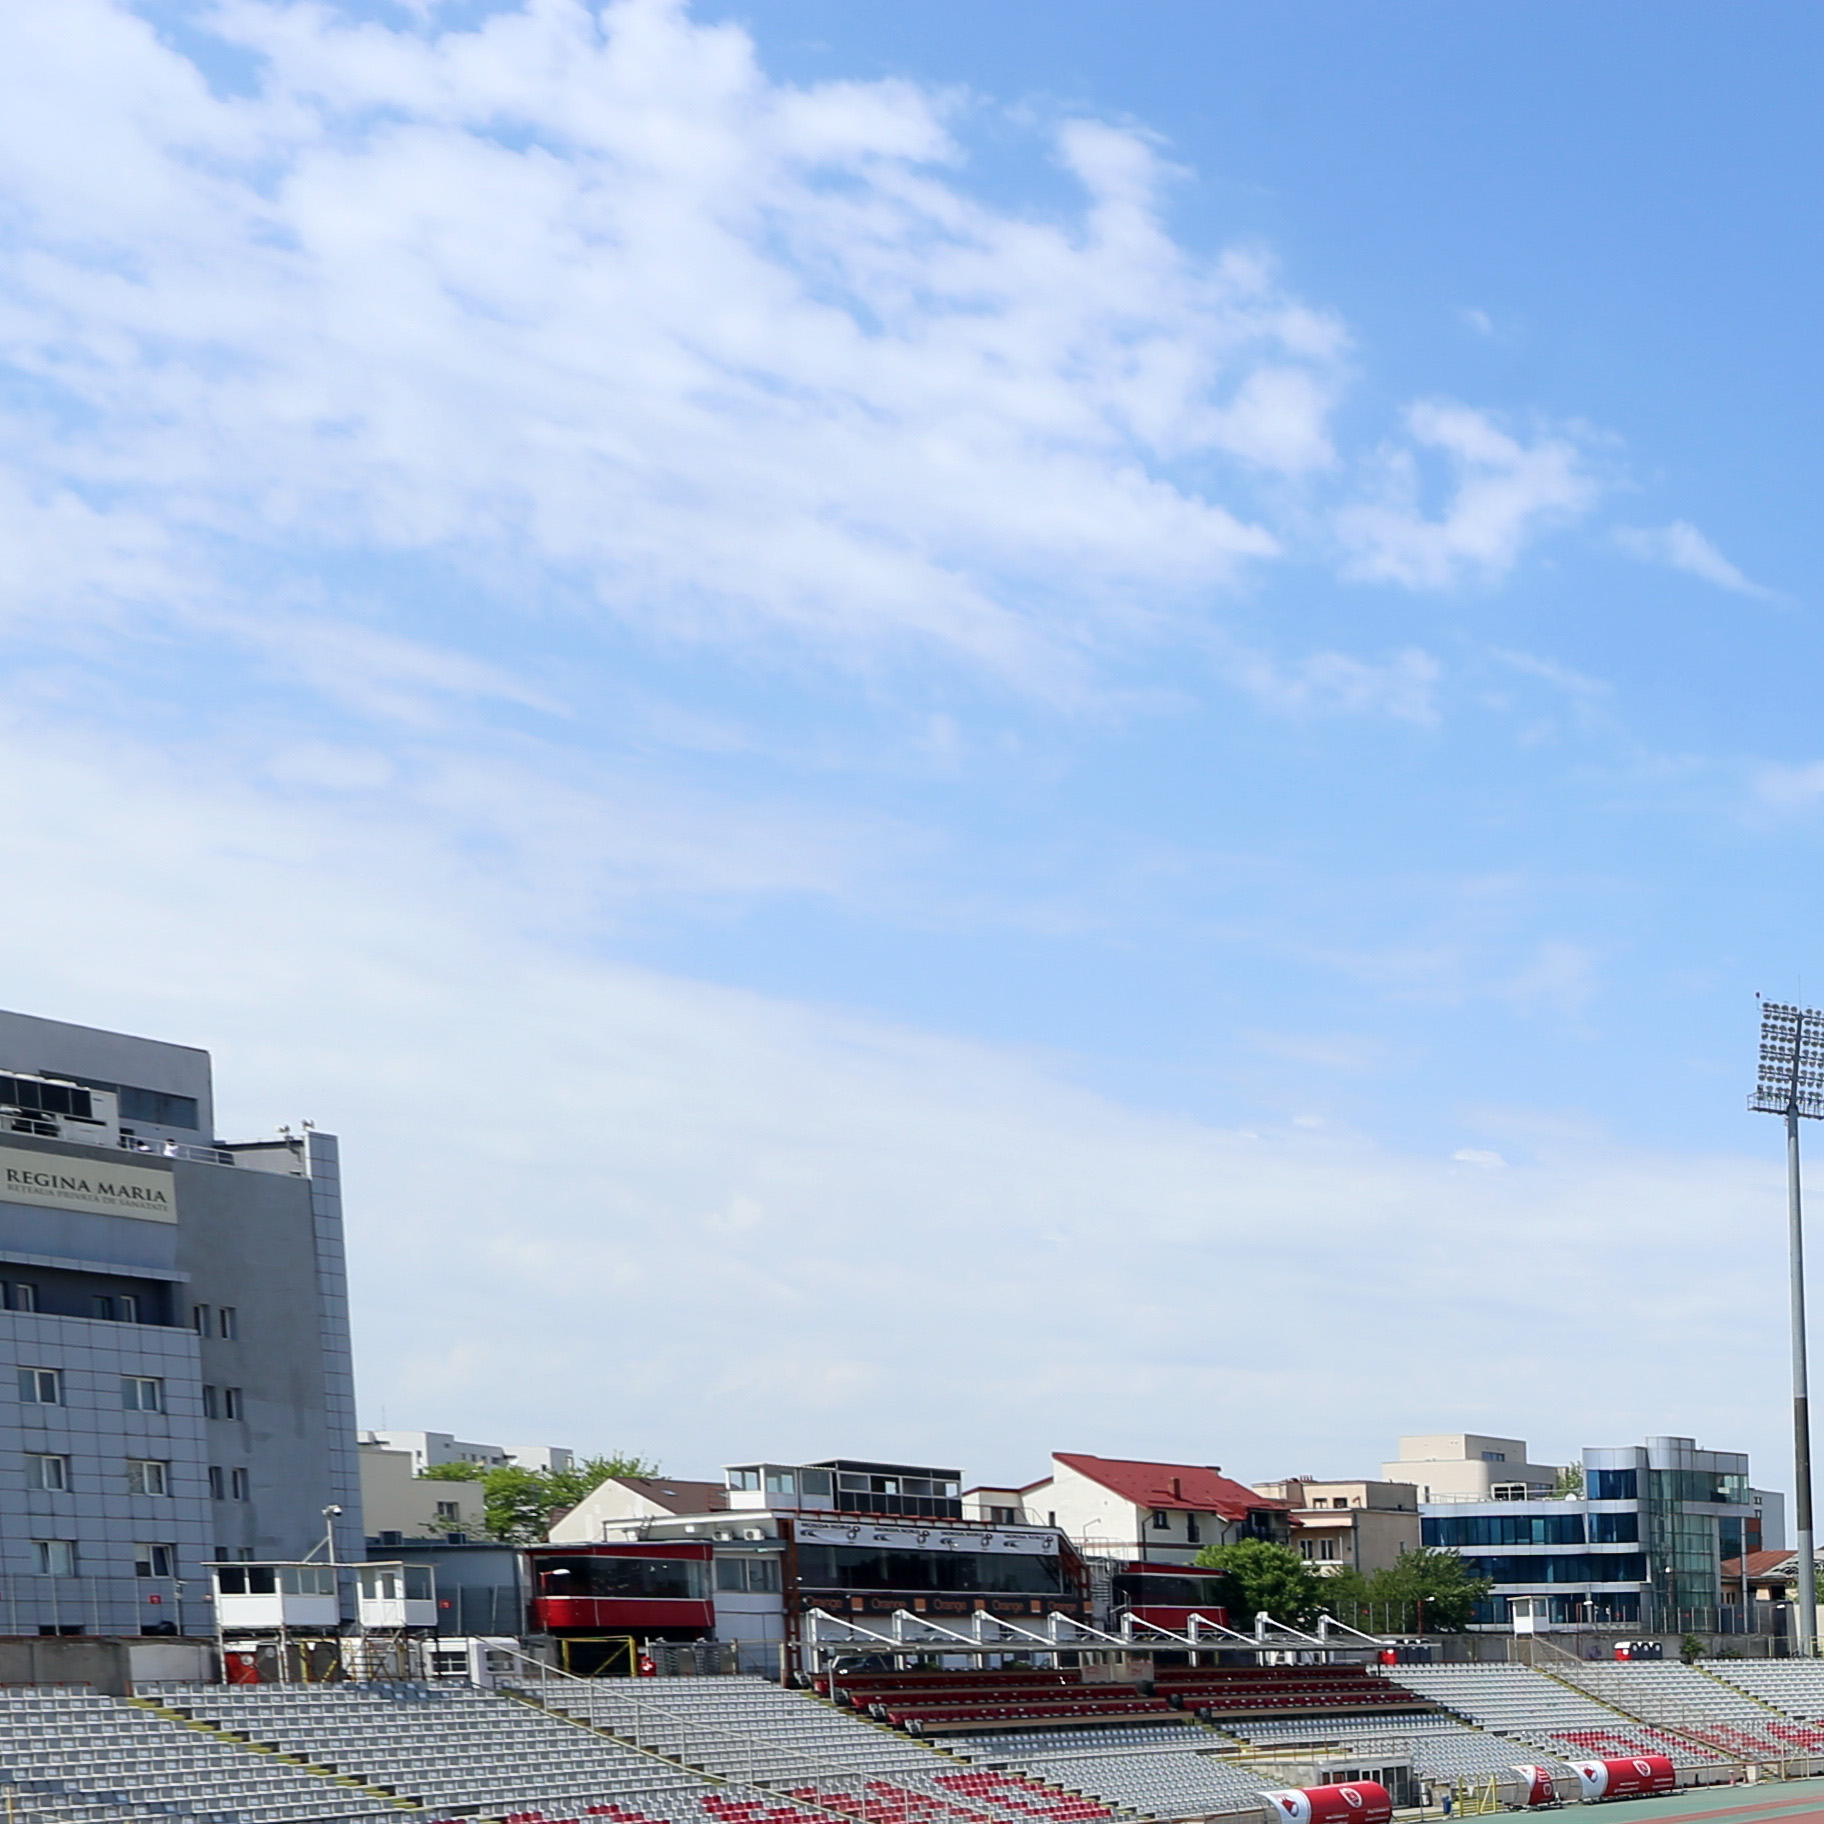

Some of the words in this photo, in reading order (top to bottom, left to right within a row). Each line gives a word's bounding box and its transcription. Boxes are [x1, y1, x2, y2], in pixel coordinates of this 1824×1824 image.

[6, 1168, 92, 1193] REGINA
[97, 1181, 168, 1203] MARIA
[805, 1595, 843, 1611] Orange
[871, 1598, 907, 1610] Orange
[933, 1598, 968, 1613] Orange
[991, 1599, 1025, 1614] Orange
[1047, 1600, 1078, 1613] Orange
